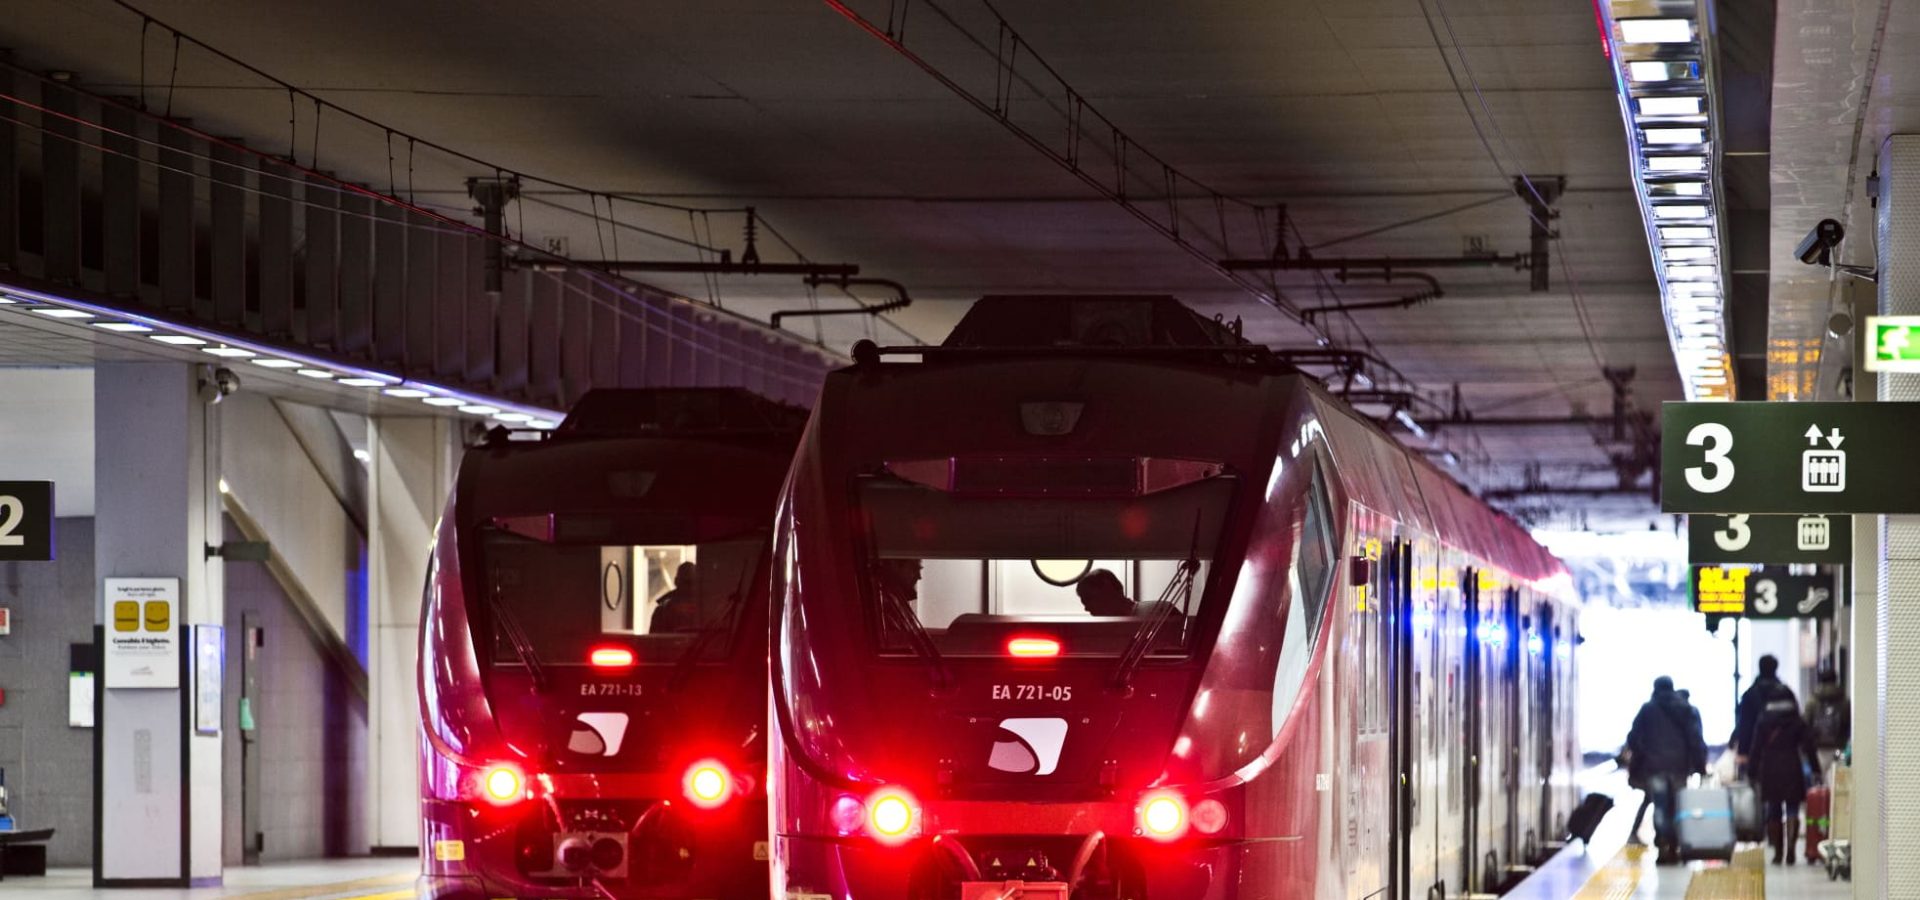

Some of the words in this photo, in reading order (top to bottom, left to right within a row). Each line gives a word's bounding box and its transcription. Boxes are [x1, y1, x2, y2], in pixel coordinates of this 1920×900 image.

[1684, 422, 1735, 493] 3
[0, 495, 25, 546] 2
[1713, 513, 1751, 551] 3
[1753, 579, 1778, 614] 3
[581, 683, 596, 696] EA
[600, 683, 642, 697] 721-13
[992, 685, 1011, 700] EA
[1016, 685, 1072, 701] 721-05
